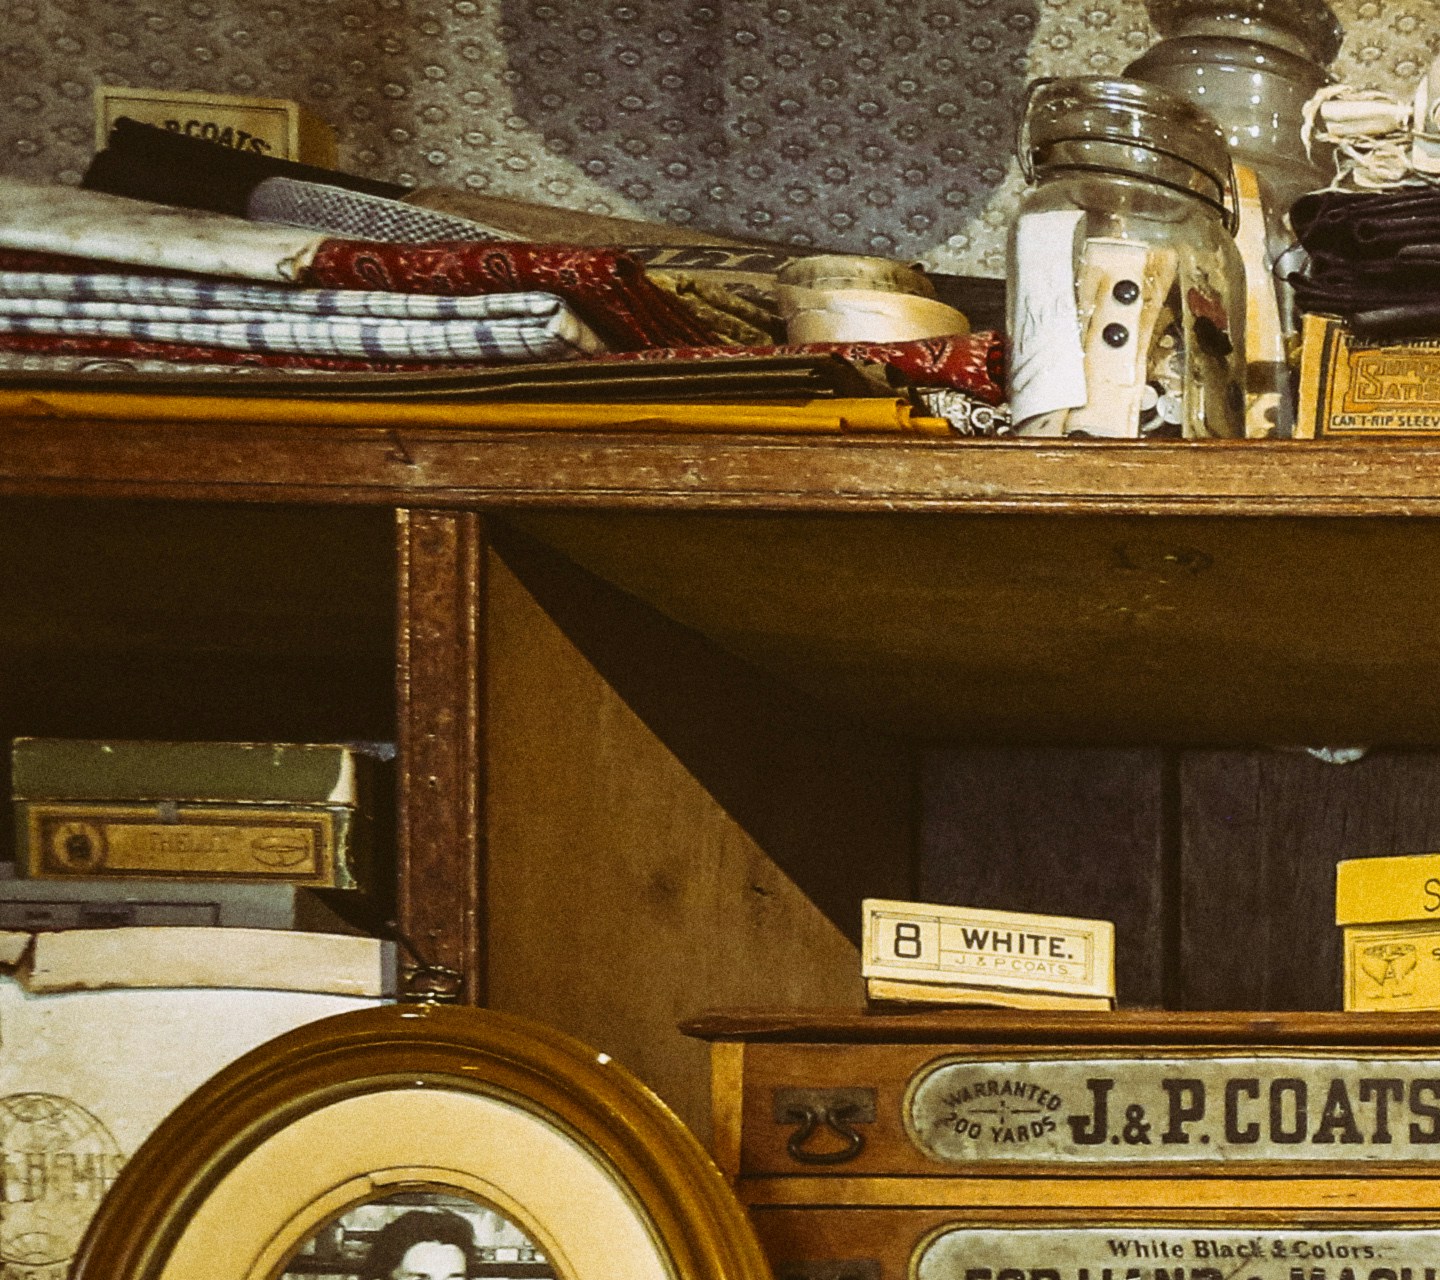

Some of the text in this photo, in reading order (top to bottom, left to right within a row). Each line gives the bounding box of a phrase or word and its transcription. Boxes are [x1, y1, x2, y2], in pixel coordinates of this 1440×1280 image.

[893, 922, 922, 959] 8
[961, 928, 1074, 960] WHITE.
[946, 1080, 1063, 1114] WARRANTED
[990, 1118, 1056, 1144] YARDS
[1108, 1238, 1264, 1259] White Black
